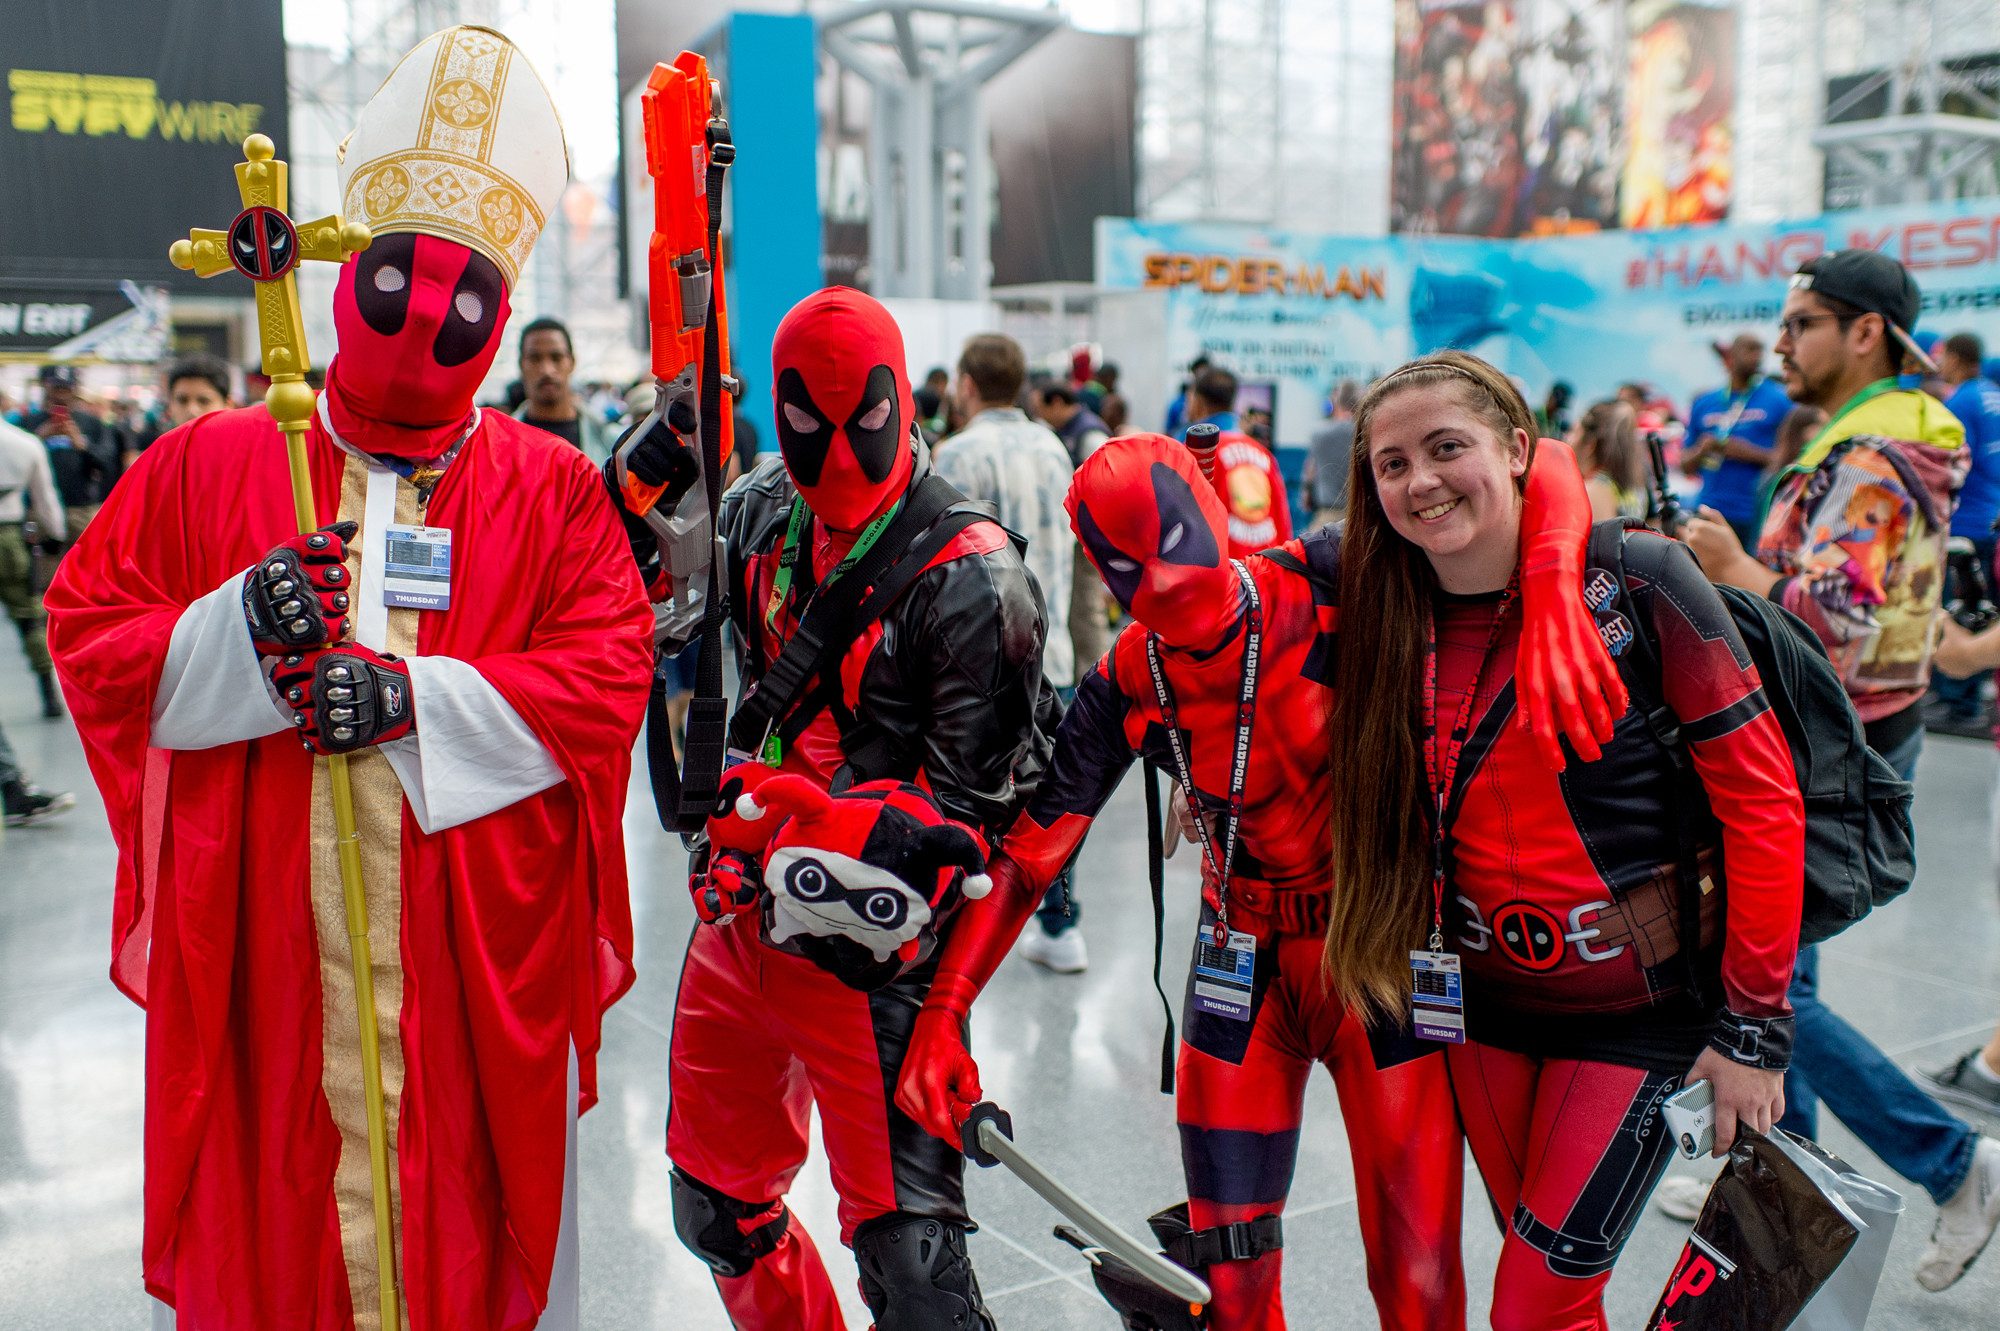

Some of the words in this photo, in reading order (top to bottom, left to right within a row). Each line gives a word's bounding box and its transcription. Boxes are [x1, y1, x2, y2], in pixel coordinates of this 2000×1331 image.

[1144, 252, 1386, 300] SPIDER-MAN
[395, 594, 440, 605] THURSDAY
[1584, 572, 1614, 610] IRST
[1599, 616, 1624, 648] RST
[1148, 640, 1168, 706] DEADPOOL
[1243, 634, 1260, 701] DEADPOOL
[1168, 729, 1191, 795] DEADPOOL
[1233, 726, 1250, 792] DEADPOOL
[1203, 1000, 1240, 1014] THURSDAY
[1423, 1027, 1457, 1039] THURSDAY
